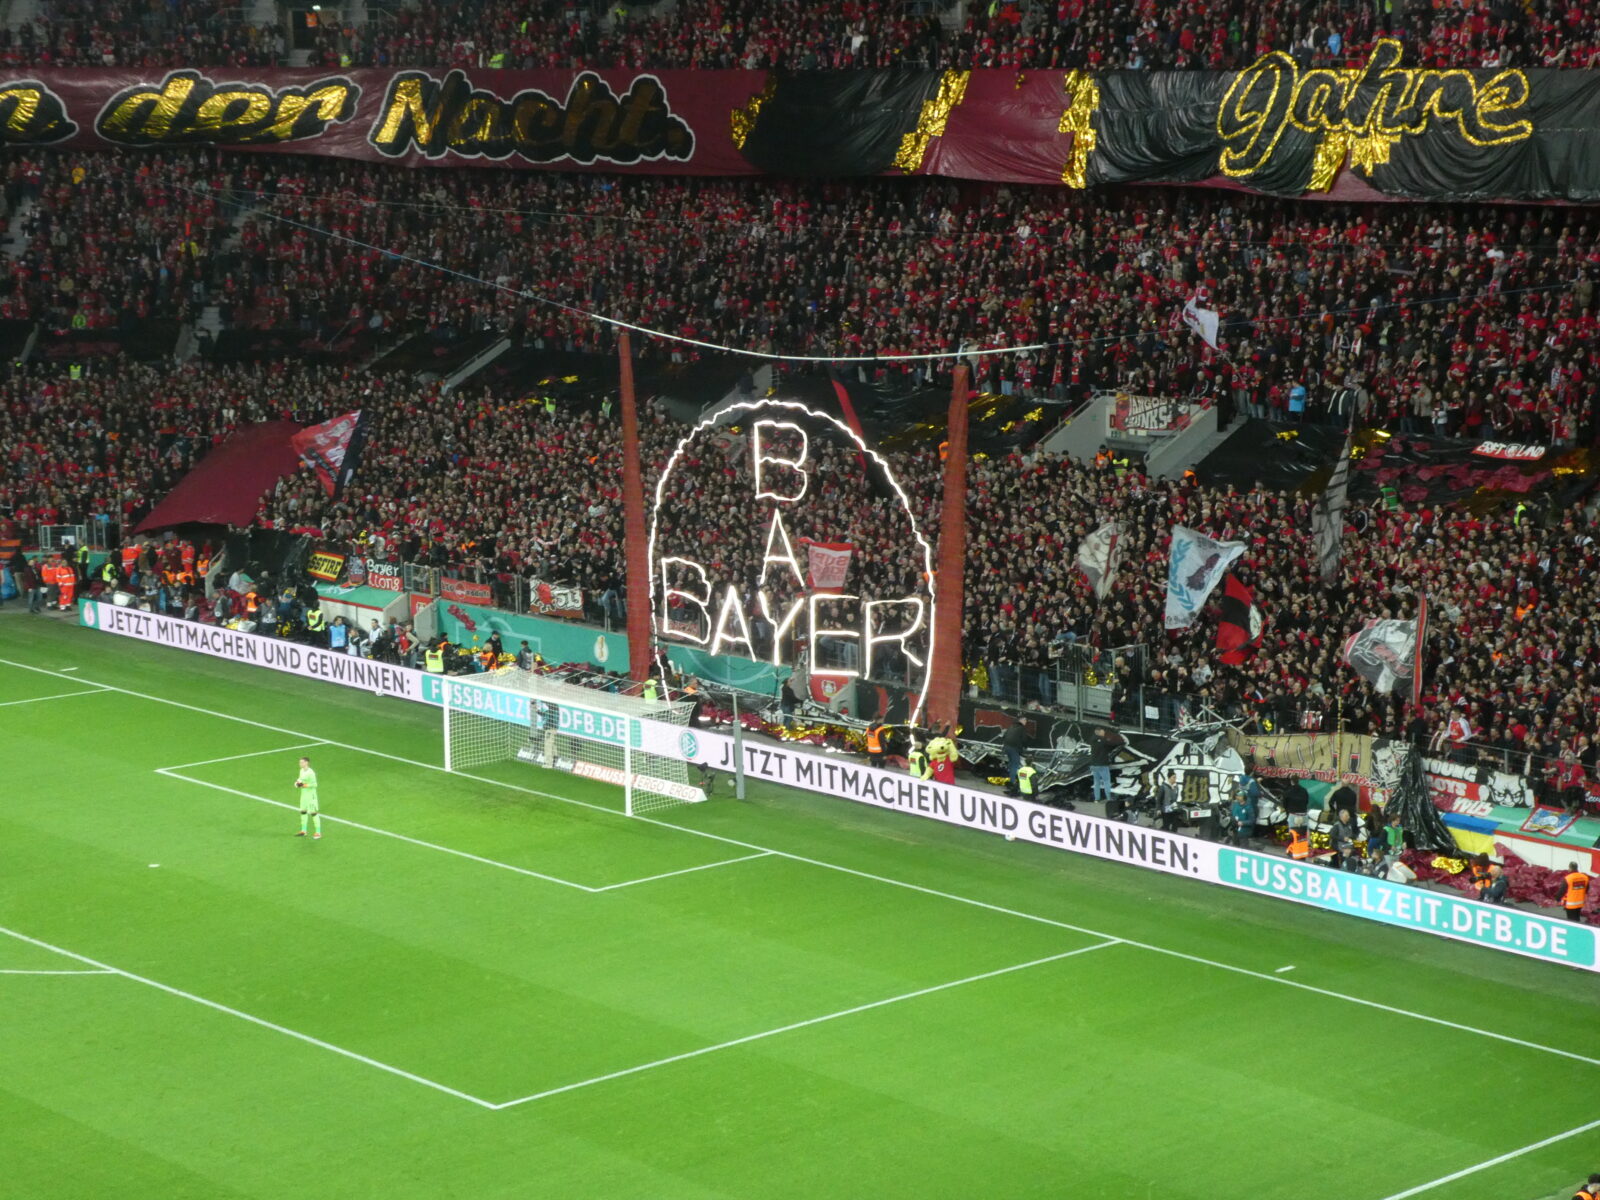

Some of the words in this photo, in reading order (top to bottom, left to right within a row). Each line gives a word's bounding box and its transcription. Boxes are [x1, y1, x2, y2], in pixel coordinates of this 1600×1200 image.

[99, 73, 355, 143] der
[366, 559, 399, 577] Bayer
[662, 555, 924, 681] BAYER
[108, 609, 152, 637] JETZT
[157, 619, 257, 660] MITMACHEN
[263, 642, 301, 669] UND
[307, 652, 411, 695] GEWINNEN:
[582, 765, 625, 785] STRAUSS
[637, 775, 664, 792] ERGO
[669, 785, 697, 800] ERGO
[1421, 757, 1478, 782] YOUNG
[795, 757, 949, 816] MITMACHEN
[960, 793, 1019, 830] UND
[1028, 810, 1199, 874] GEWINNEN:
[1235, 855, 1567, 956] FUSSBALLZEIT.DFB.DE
